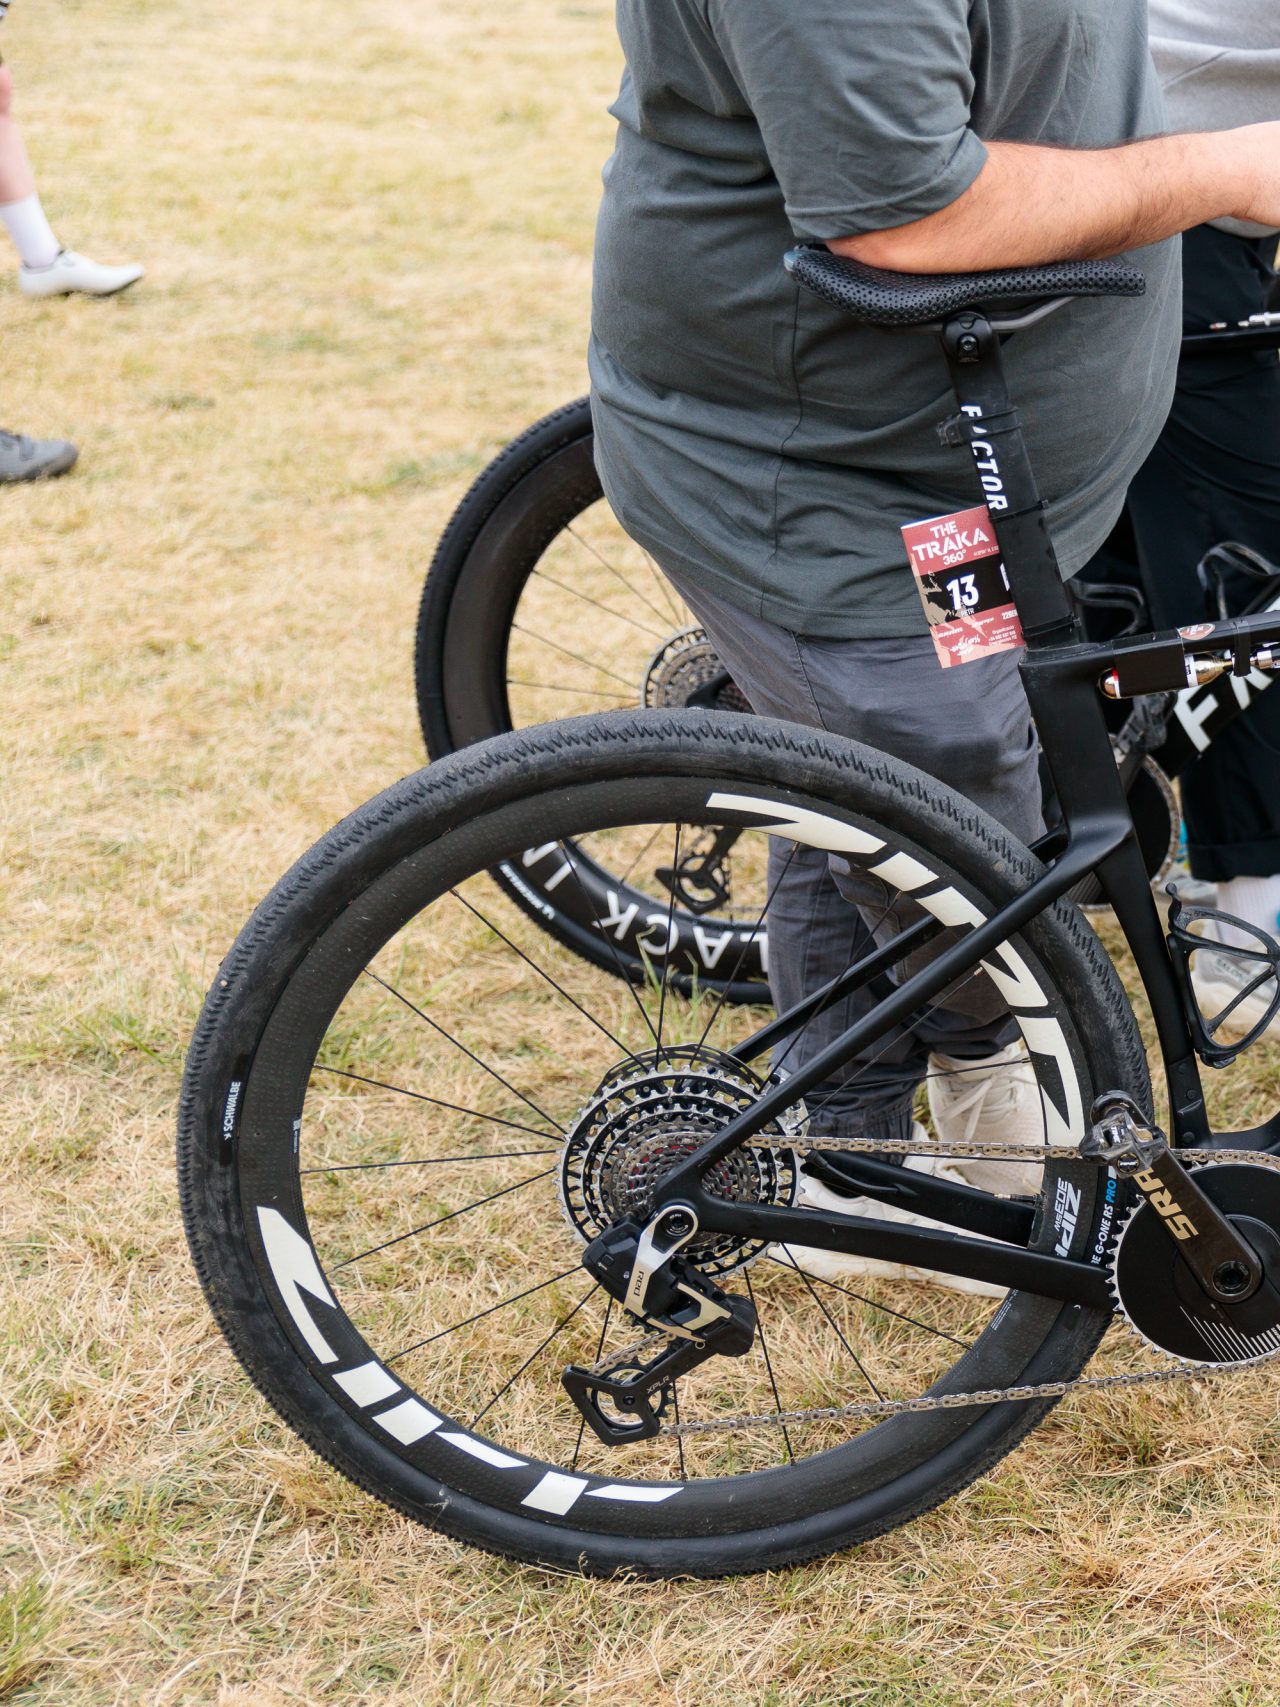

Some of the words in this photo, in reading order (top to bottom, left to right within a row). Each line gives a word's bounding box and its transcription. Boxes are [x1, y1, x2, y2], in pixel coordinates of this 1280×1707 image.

[912, 528, 989, 561] TRAKA
[930, 521, 958, 538] THE
[946, 574, 979, 610] 13
[591, 889, 769, 972] LACK
[223, 1081, 241, 1132] SCHWALBE
[1105, 1179, 1117, 1203] PRO
[1132, 1167, 1200, 1240] SRA
[1102, 1203, 1114, 1219] RS
[1095, 1219, 1111, 1254] G-ONE
[647, 1375, 670, 1394] XPLR
